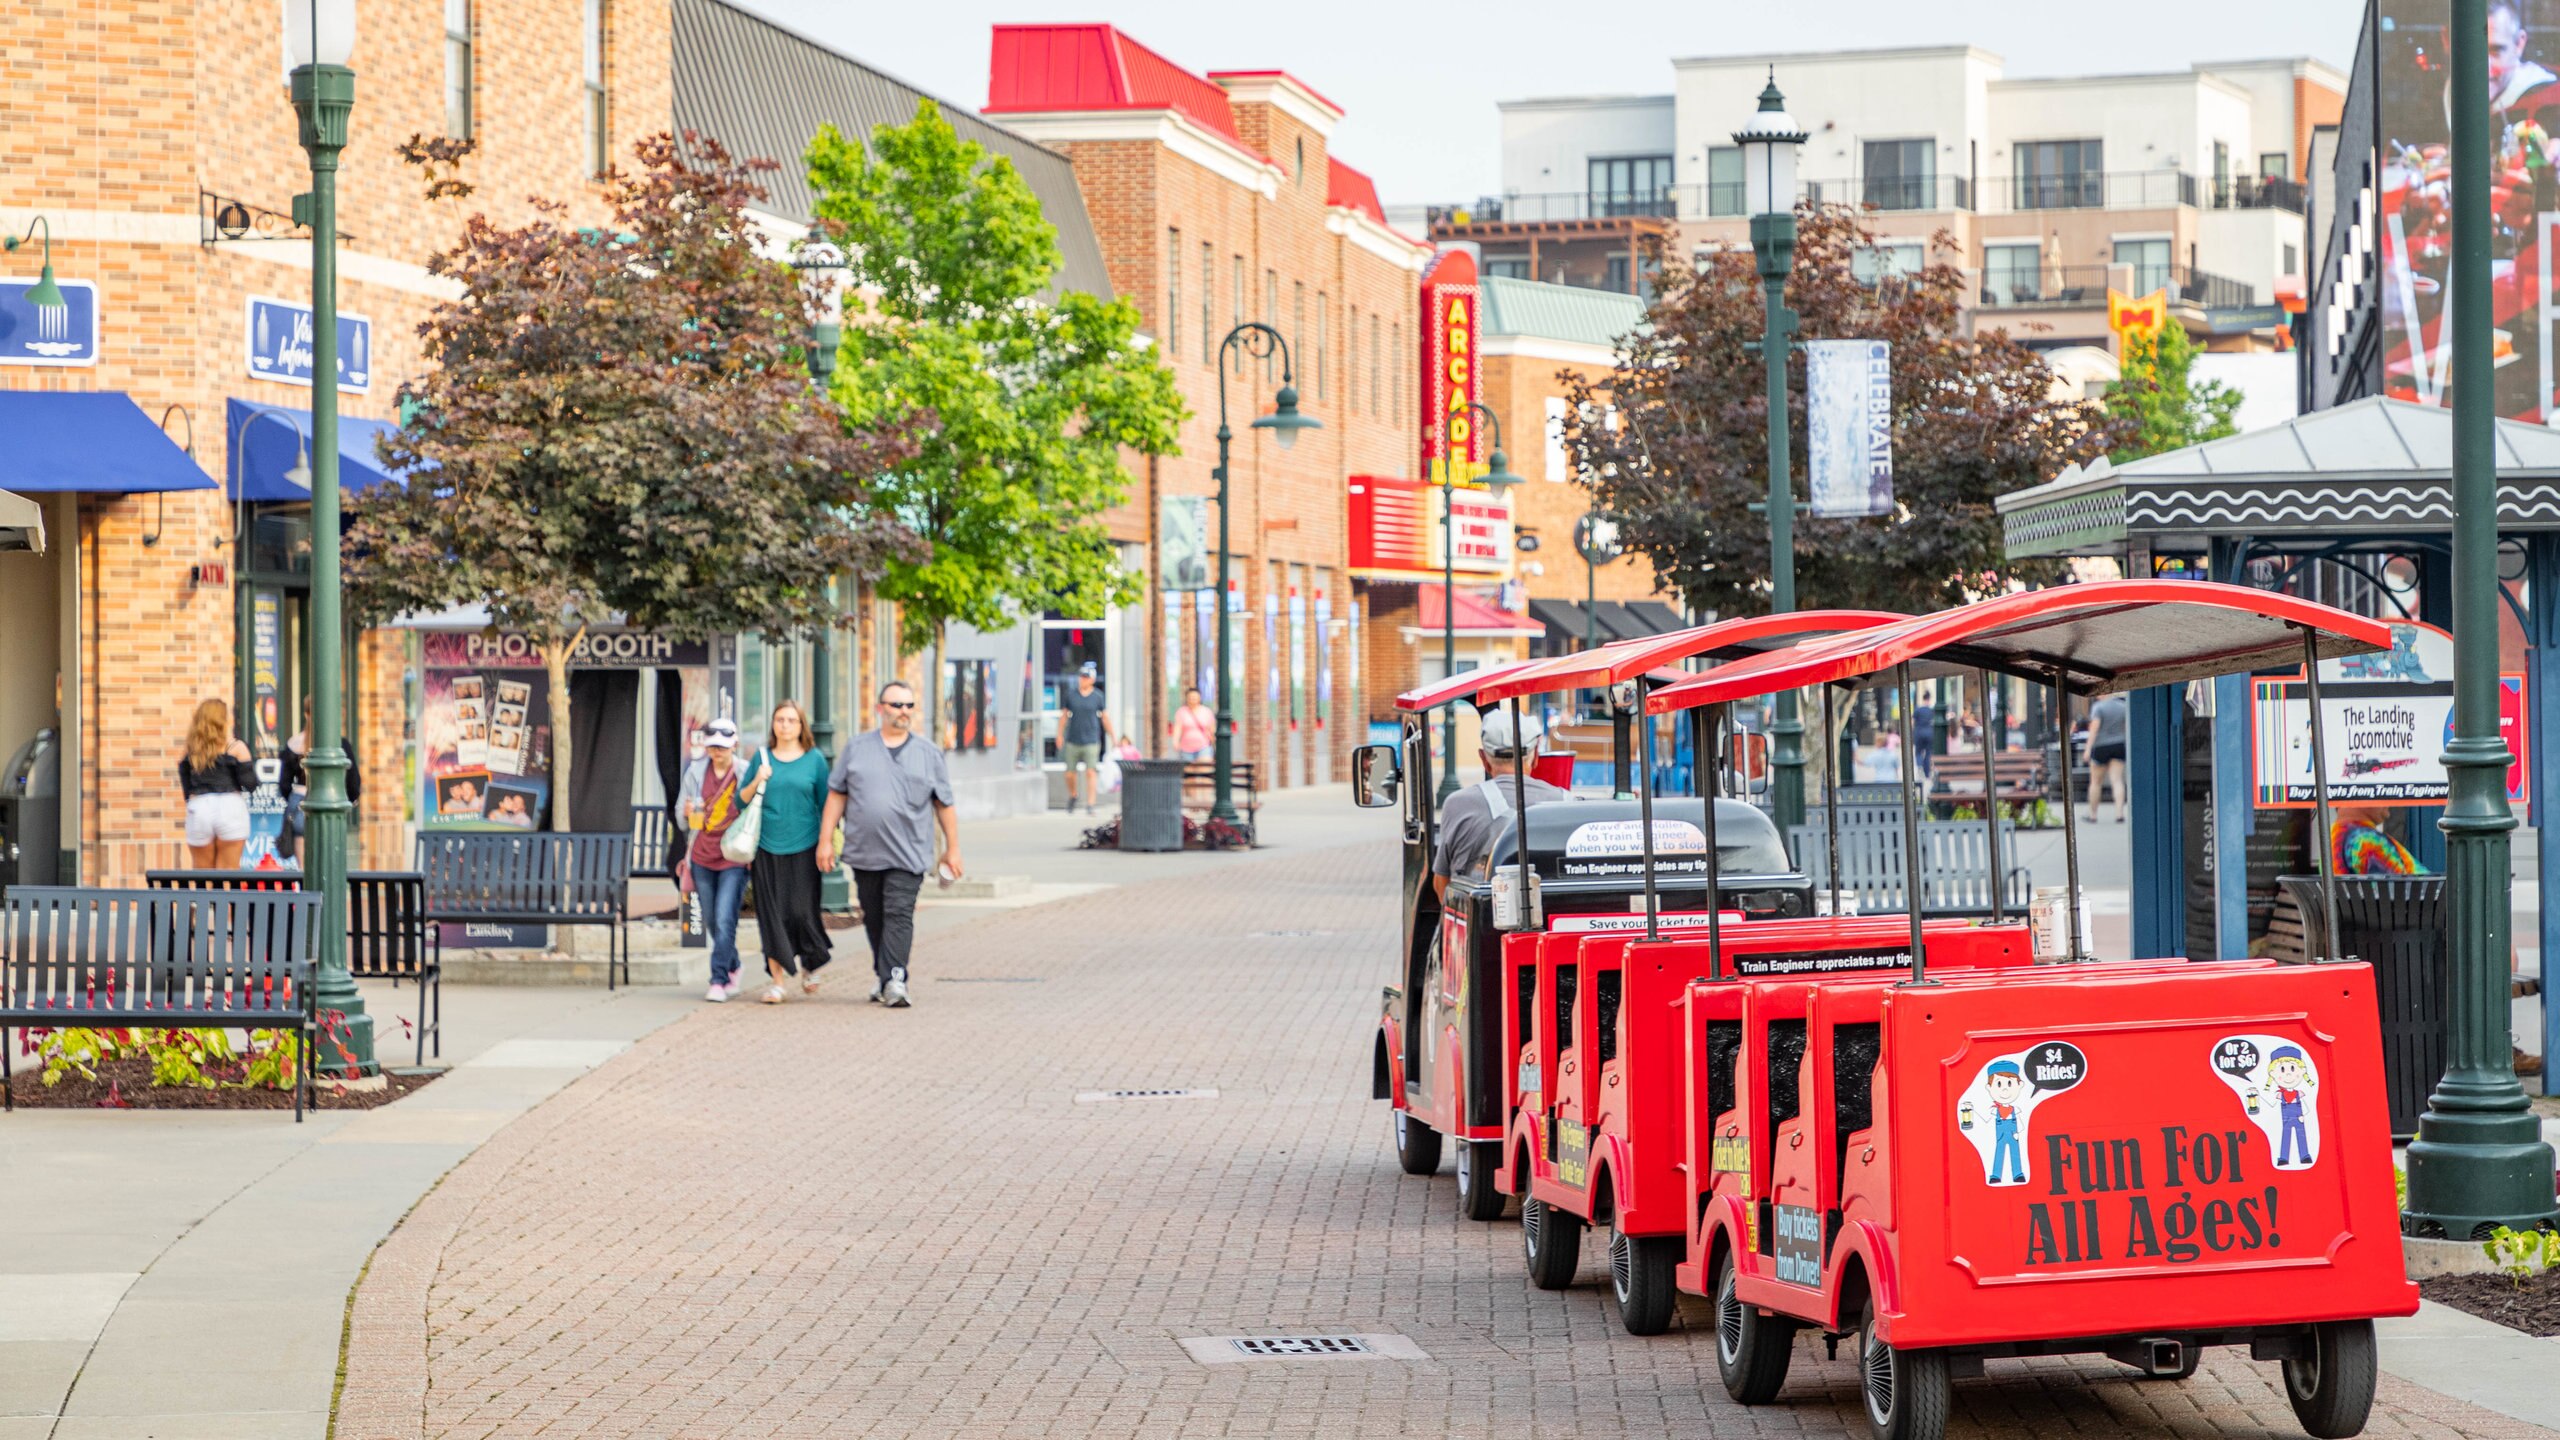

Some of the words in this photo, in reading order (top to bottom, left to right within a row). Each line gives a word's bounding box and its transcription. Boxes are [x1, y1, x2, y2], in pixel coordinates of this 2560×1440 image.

[1447, 298, 1470, 468] ARCADE
[1868, 340, 1892, 476] CELEBRATE
[201, 564, 226, 585] ATM
[575, 633, 672, 658] BOOTH
[2343, 706, 2365, 728] The
[2368, 705, 2415, 731] Landing
[2348, 727, 2413, 751] Locomotive
[2289, 786, 2312, 799] Buy
[2347, 784, 2375, 799] from
[2374, 783, 2403, 797] Train
[2405, 783, 2450, 798] Engineer
[2203, 807, 2213, 822] 2
[1588, 822, 1621, 831] Wave
[2203, 823, 2213, 838] 3
[1587, 833, 1599, 842] to
[1602, 831, 1631, 841] Train
[1636, 830, 1688, 842] Egineer
[1569, 844, 1601, 853] when
[1605, 843, 1627, 854] you
[1630, 842, 1660, 852] wat
[1663, 841, 1676, 851] to
[2203, 840, 2213, 854] 4
[1565, 863, 1588, 875] Train
[1589, 862, 1626, 876] Engineer
[1678, 861, 1693, 873] any
[2203, 856, 2214, 871] 5
[1589, 918, 1618, 929] Save
[1622, 919, 1648, 930] your
[1656, 916, 1685, 927] icket
[1689, 916, 1706, 926] for
[1742, 961, 1768, 973] Train
[1769, 958, 1814, 974] Engineer
[1815, 955, 1874, 972] appreciates
[1876, 956, 1895, 968] any
[2045, 1048, 2063, 1064] $4
[2225, 1042, 2239, 1056] Or
[2240, 1041, 2250, 1055] 2
[2219, 1055, 2236, 1069] for
[2237, 1053, 2257, 1069] $6!
[2036, 1063, 2077, 1081] Rides!
[2045, 1133, 2144, 1196] Fun
[2160, 1125, 2247, 1188] For
[1778, 1206, 1793, 1245] Buy
[1793, 1208, 1819, 1242] tickets
[2025, 1199, 2103, 1266] All
[2125, 1185, 2282, 1264] Ages!
[1777, 1247, 1794, 1280] from
[1795, 1251, 1821, 1286] Driver!
